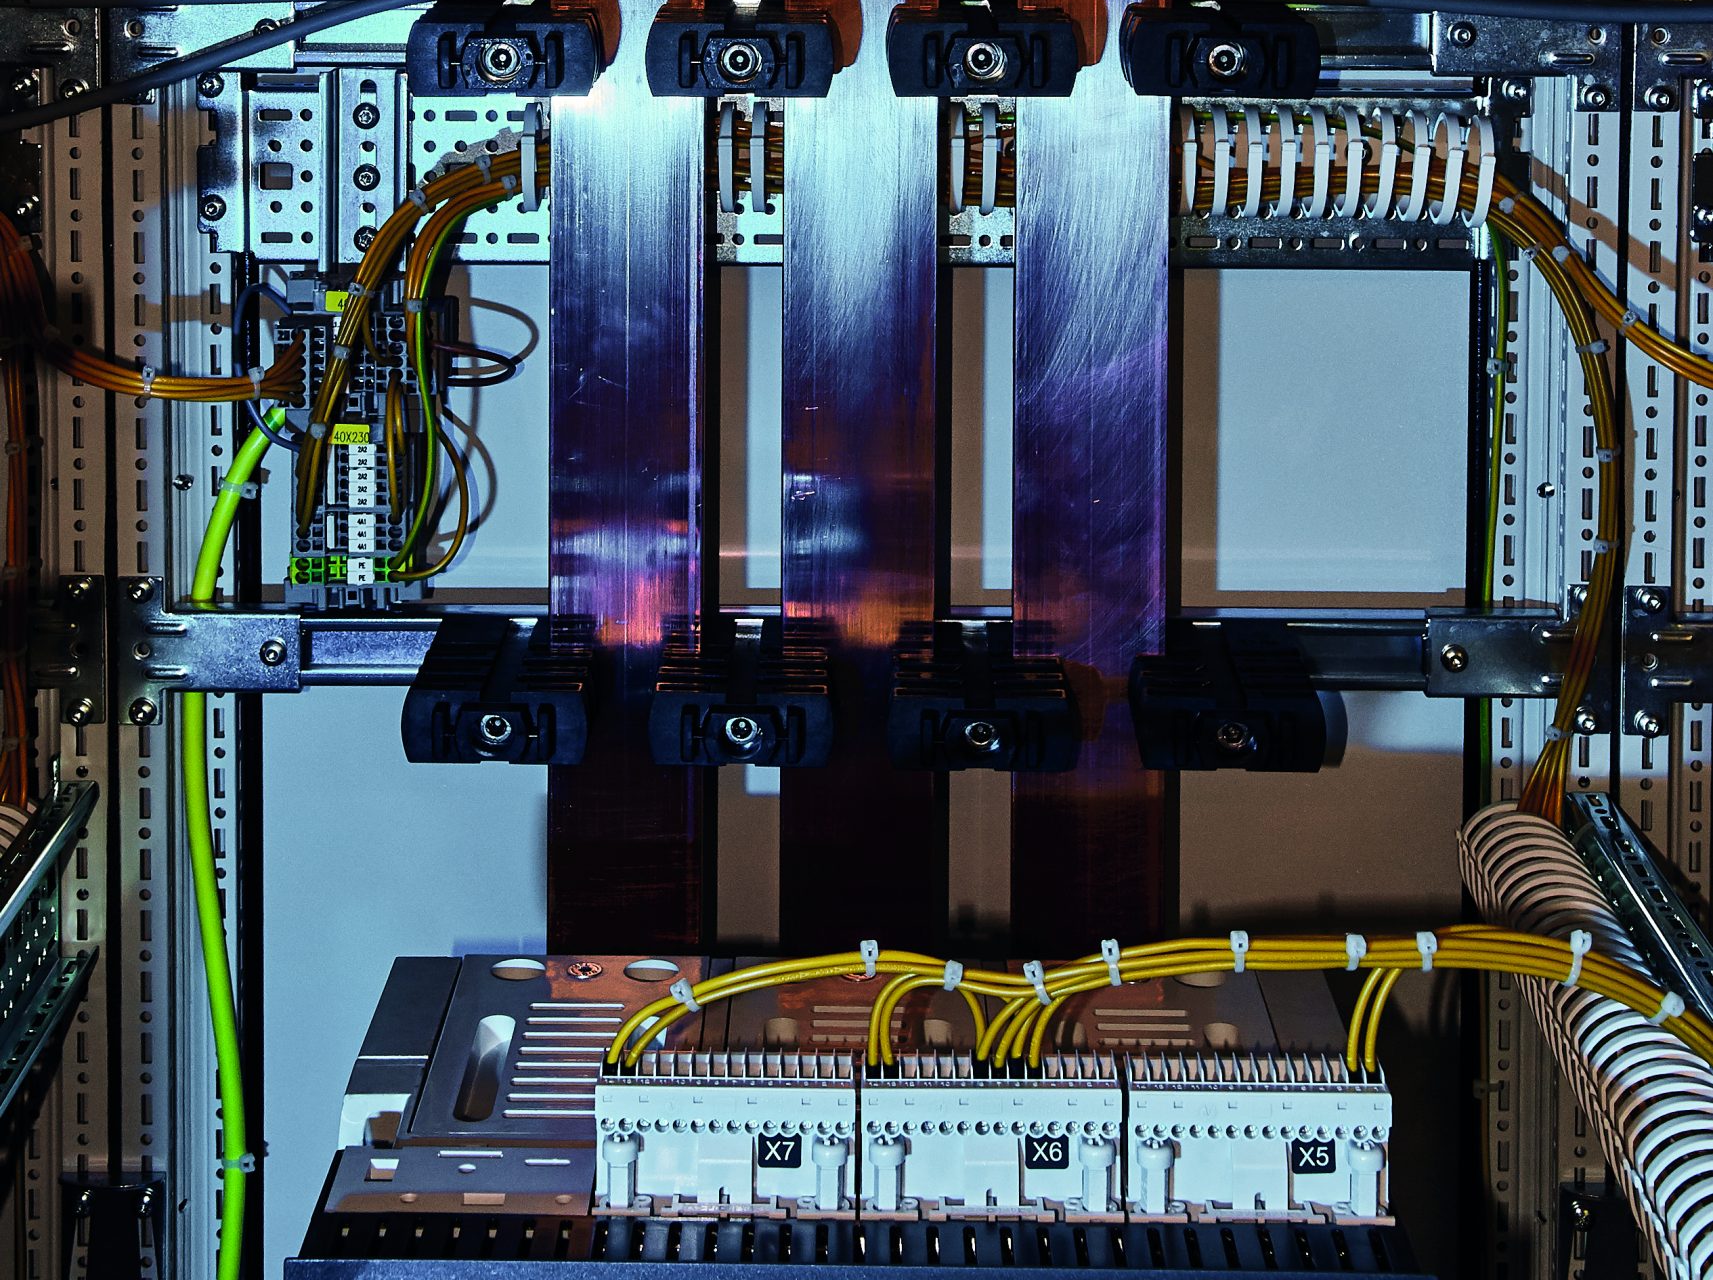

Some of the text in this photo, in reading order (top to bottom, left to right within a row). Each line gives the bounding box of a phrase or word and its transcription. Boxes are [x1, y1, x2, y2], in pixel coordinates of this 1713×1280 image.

[765, 1140, 795, 1161] X7
[1032, 1141, 1063, 1162] X6
[1299, 1146, 1329, 1166] X5
